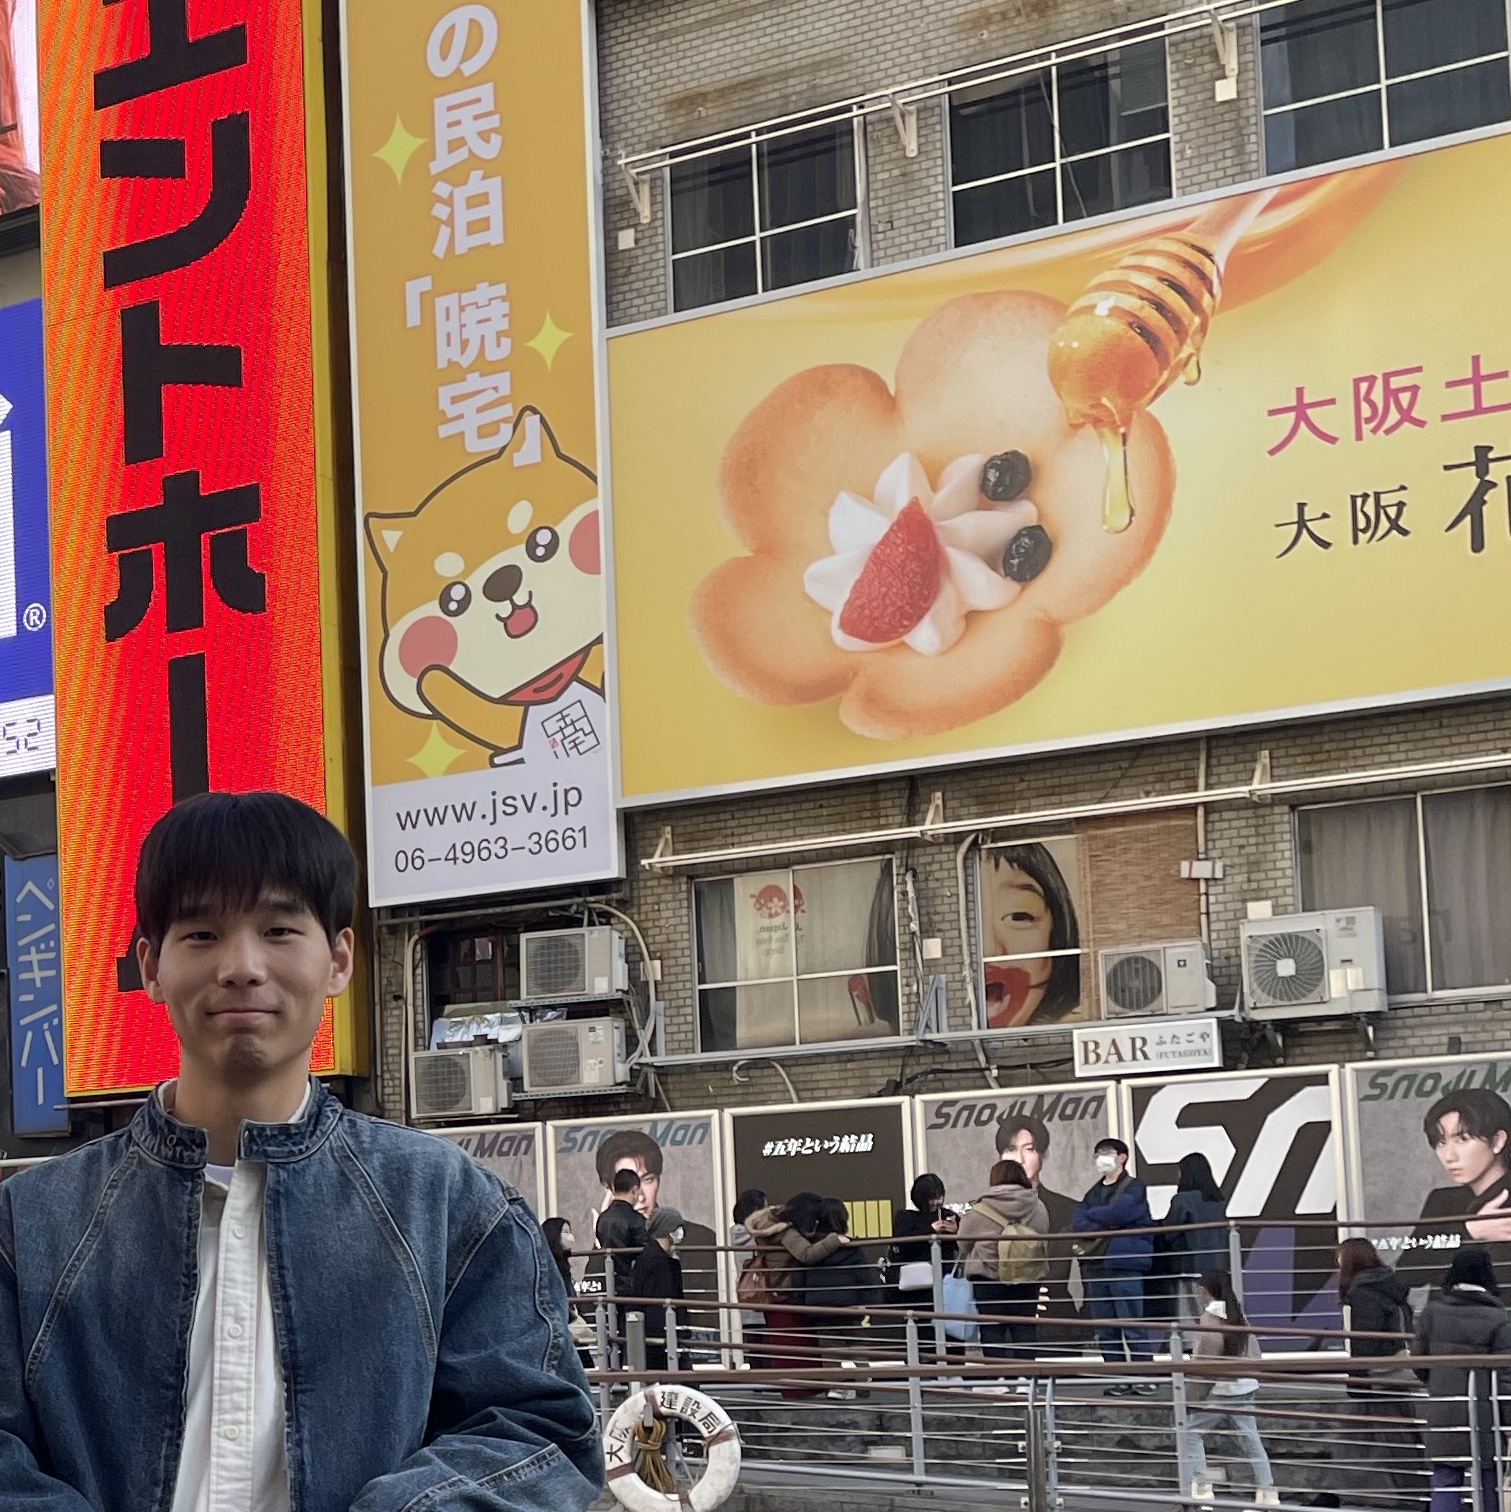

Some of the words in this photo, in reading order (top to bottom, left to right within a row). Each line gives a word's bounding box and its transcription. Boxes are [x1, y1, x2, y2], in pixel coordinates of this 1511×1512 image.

[395, 782, 583, 831] www.jsv.jp
[394, 826, 588, 873] 06-4963-3661
[15, 877, 60, 1106] ペンギンバー
[1081, 1036, 1151, 1065] BAR
[1155, 1031, 1210, 1046] ふたごや
[1031, 1093, 1106, 1122] Man
[473, 1132, 535, 1158] Man
[647, 1119, 711, 1148] Man
[660, 1391, 721, 1434] 建設局
